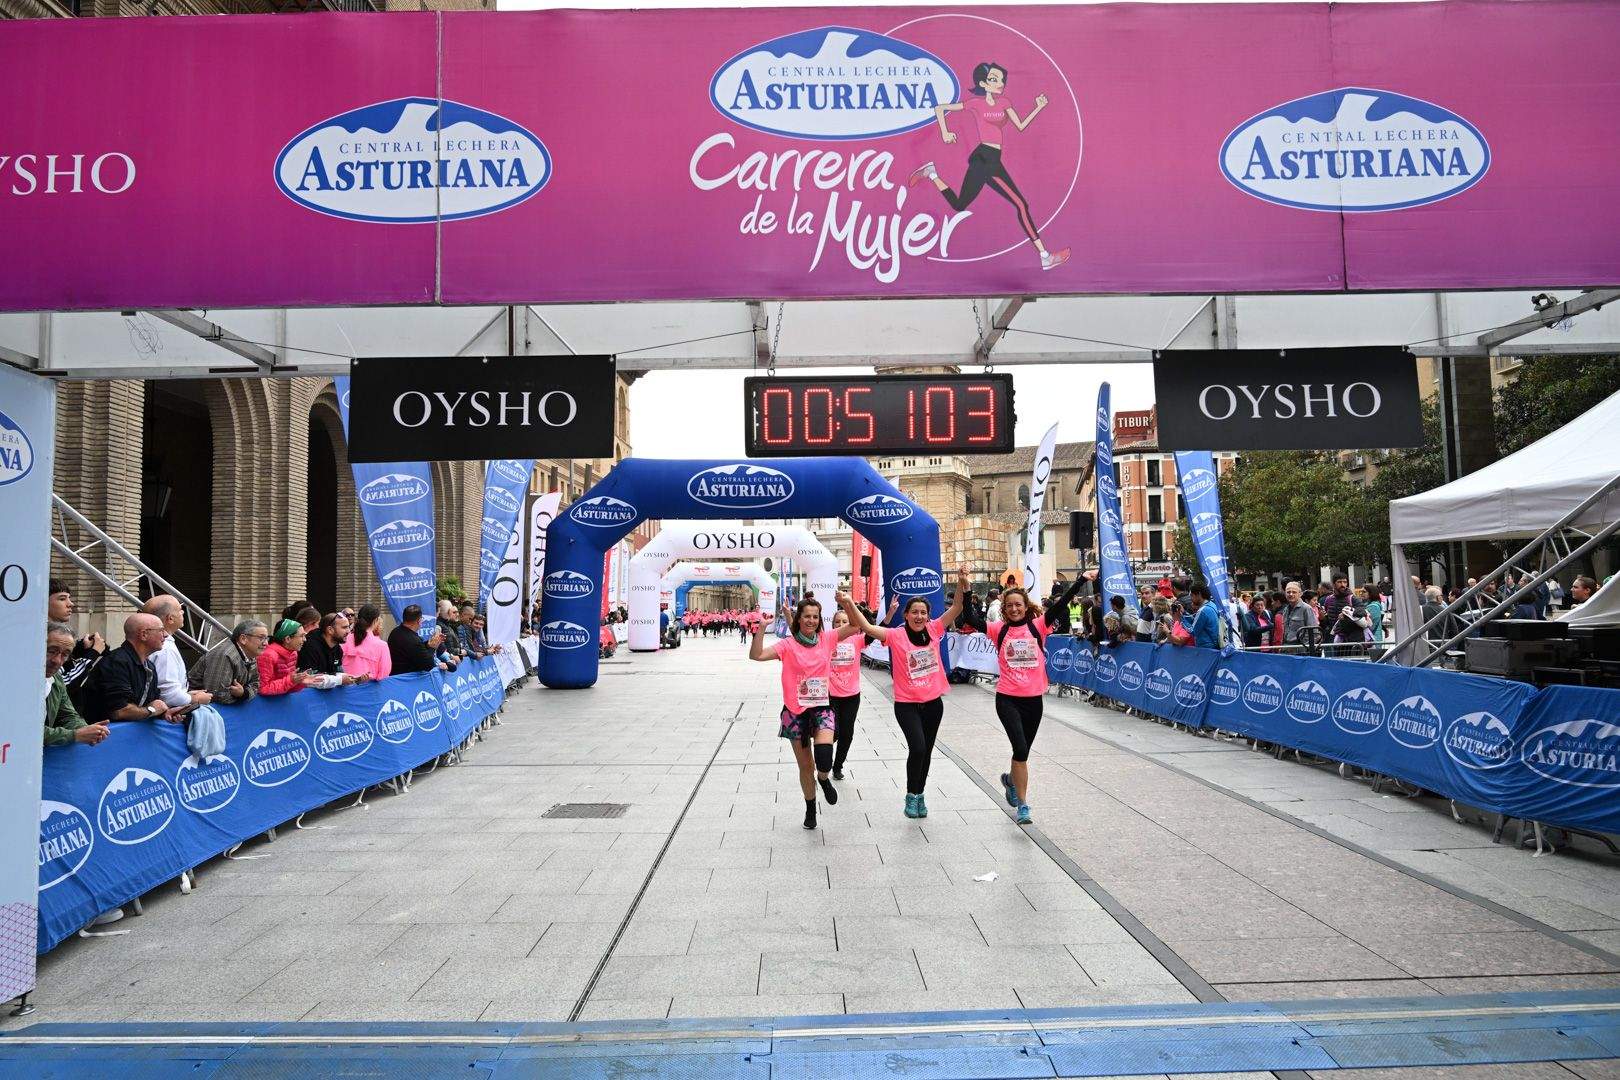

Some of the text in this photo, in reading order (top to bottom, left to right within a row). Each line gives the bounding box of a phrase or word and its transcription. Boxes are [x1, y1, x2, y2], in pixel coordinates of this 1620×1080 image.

[768, 65, 932, 77] CENTRAL LECHERA
[729, 68, 940, 111] ASTURIANA
[339, 140, 522, 154] CENTRAL LECHERA
[1282, 130, 1460, 144] CENTRAL LECHERA
[295, 146, 531, 192] ASTURIANA
[689, 132, 895, 191] Carrera
[1242, 135, 1471, 182] ASTURIANA
[740, 185, 973, 283] de la Mujer
[392, 390, 578, 428] OYSHO
[1198, 382, 1382, 421] OYSHO
[1118, 416, 1150, 428] TIBUR
[696, 478, 787, 498] ASTURIANA
[574, 506, 632, 520] ASTURIANA
[851, 506, 910, 518] ASTURIANA
[692, 532, 776, 550] OYSHO
[545, 582, 590, 593] ASTURIANA
[894, 577, 940, 590] ASTURIANA
[542, 630, 586, 643] ASTURIANA
[1245, 686, 1280, 706] ASTURIANA
[1288, 694, 1326, 716] ASTURIANA
[1335, 704, 1380, 727] ASTURIANA
[320, 729, 372, 756] ASTURIANA
[250, 748, 308, 780] ASTURIANA
[1529, 738, 1620, 772] ASTURIA
[113, 784, 164, 808] CENTRAL LECHERA
[182, 771, 238, 803] ASTURIANA
[106, 792, 173, 836] ASTURIANA
[46, 816, 80, 836] LECHERA
